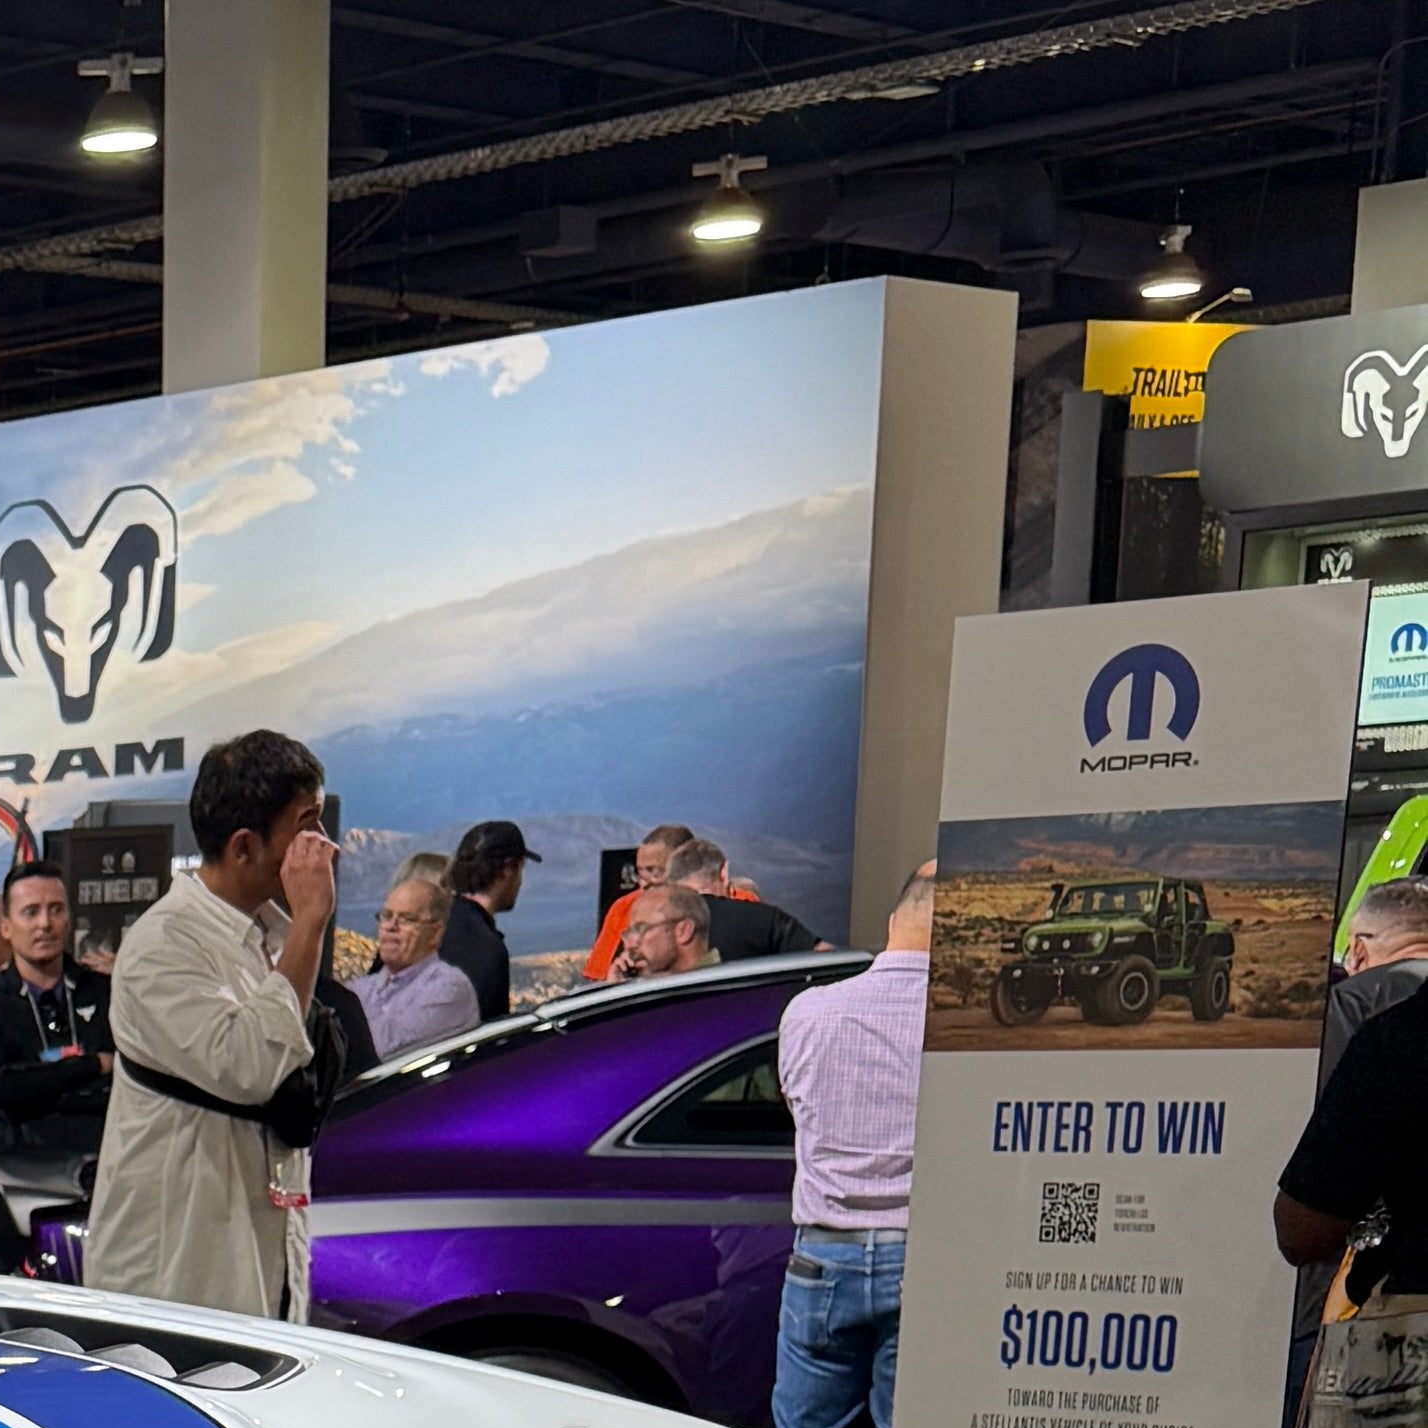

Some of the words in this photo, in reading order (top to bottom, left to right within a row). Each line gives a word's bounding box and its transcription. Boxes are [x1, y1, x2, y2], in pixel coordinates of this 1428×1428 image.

[1080, 751, 1192, 773] MOPAR
[993, 1101, 1094, 1152] ENTER
[1105, 1101, 1145, 1153] TO
[1157, 1101, 1226, 1154] WIN
[1005, 1271, 1033, 1290] SIGN
[1036, 1272, 1050, 1290] UP
[1054, 1272, 1076, 1291] FOR
[1079, 1274, 1087, 1291] A
[1091, 1274, 1137, 1293] CHANCE
[1141, 1275, 1156, 1294] TO
[1159, 1276, 1184, 1295] WIN
[1000, 1304, 1178, 1376] $100,000
[1007, 1387, 1054, 1409] TOWARD
[1058, 1391, 1078, 1409] THE
[1081, 1392, 1142, 1414] PURCHASE
[1146, 1395, 1160, 1415] OF
